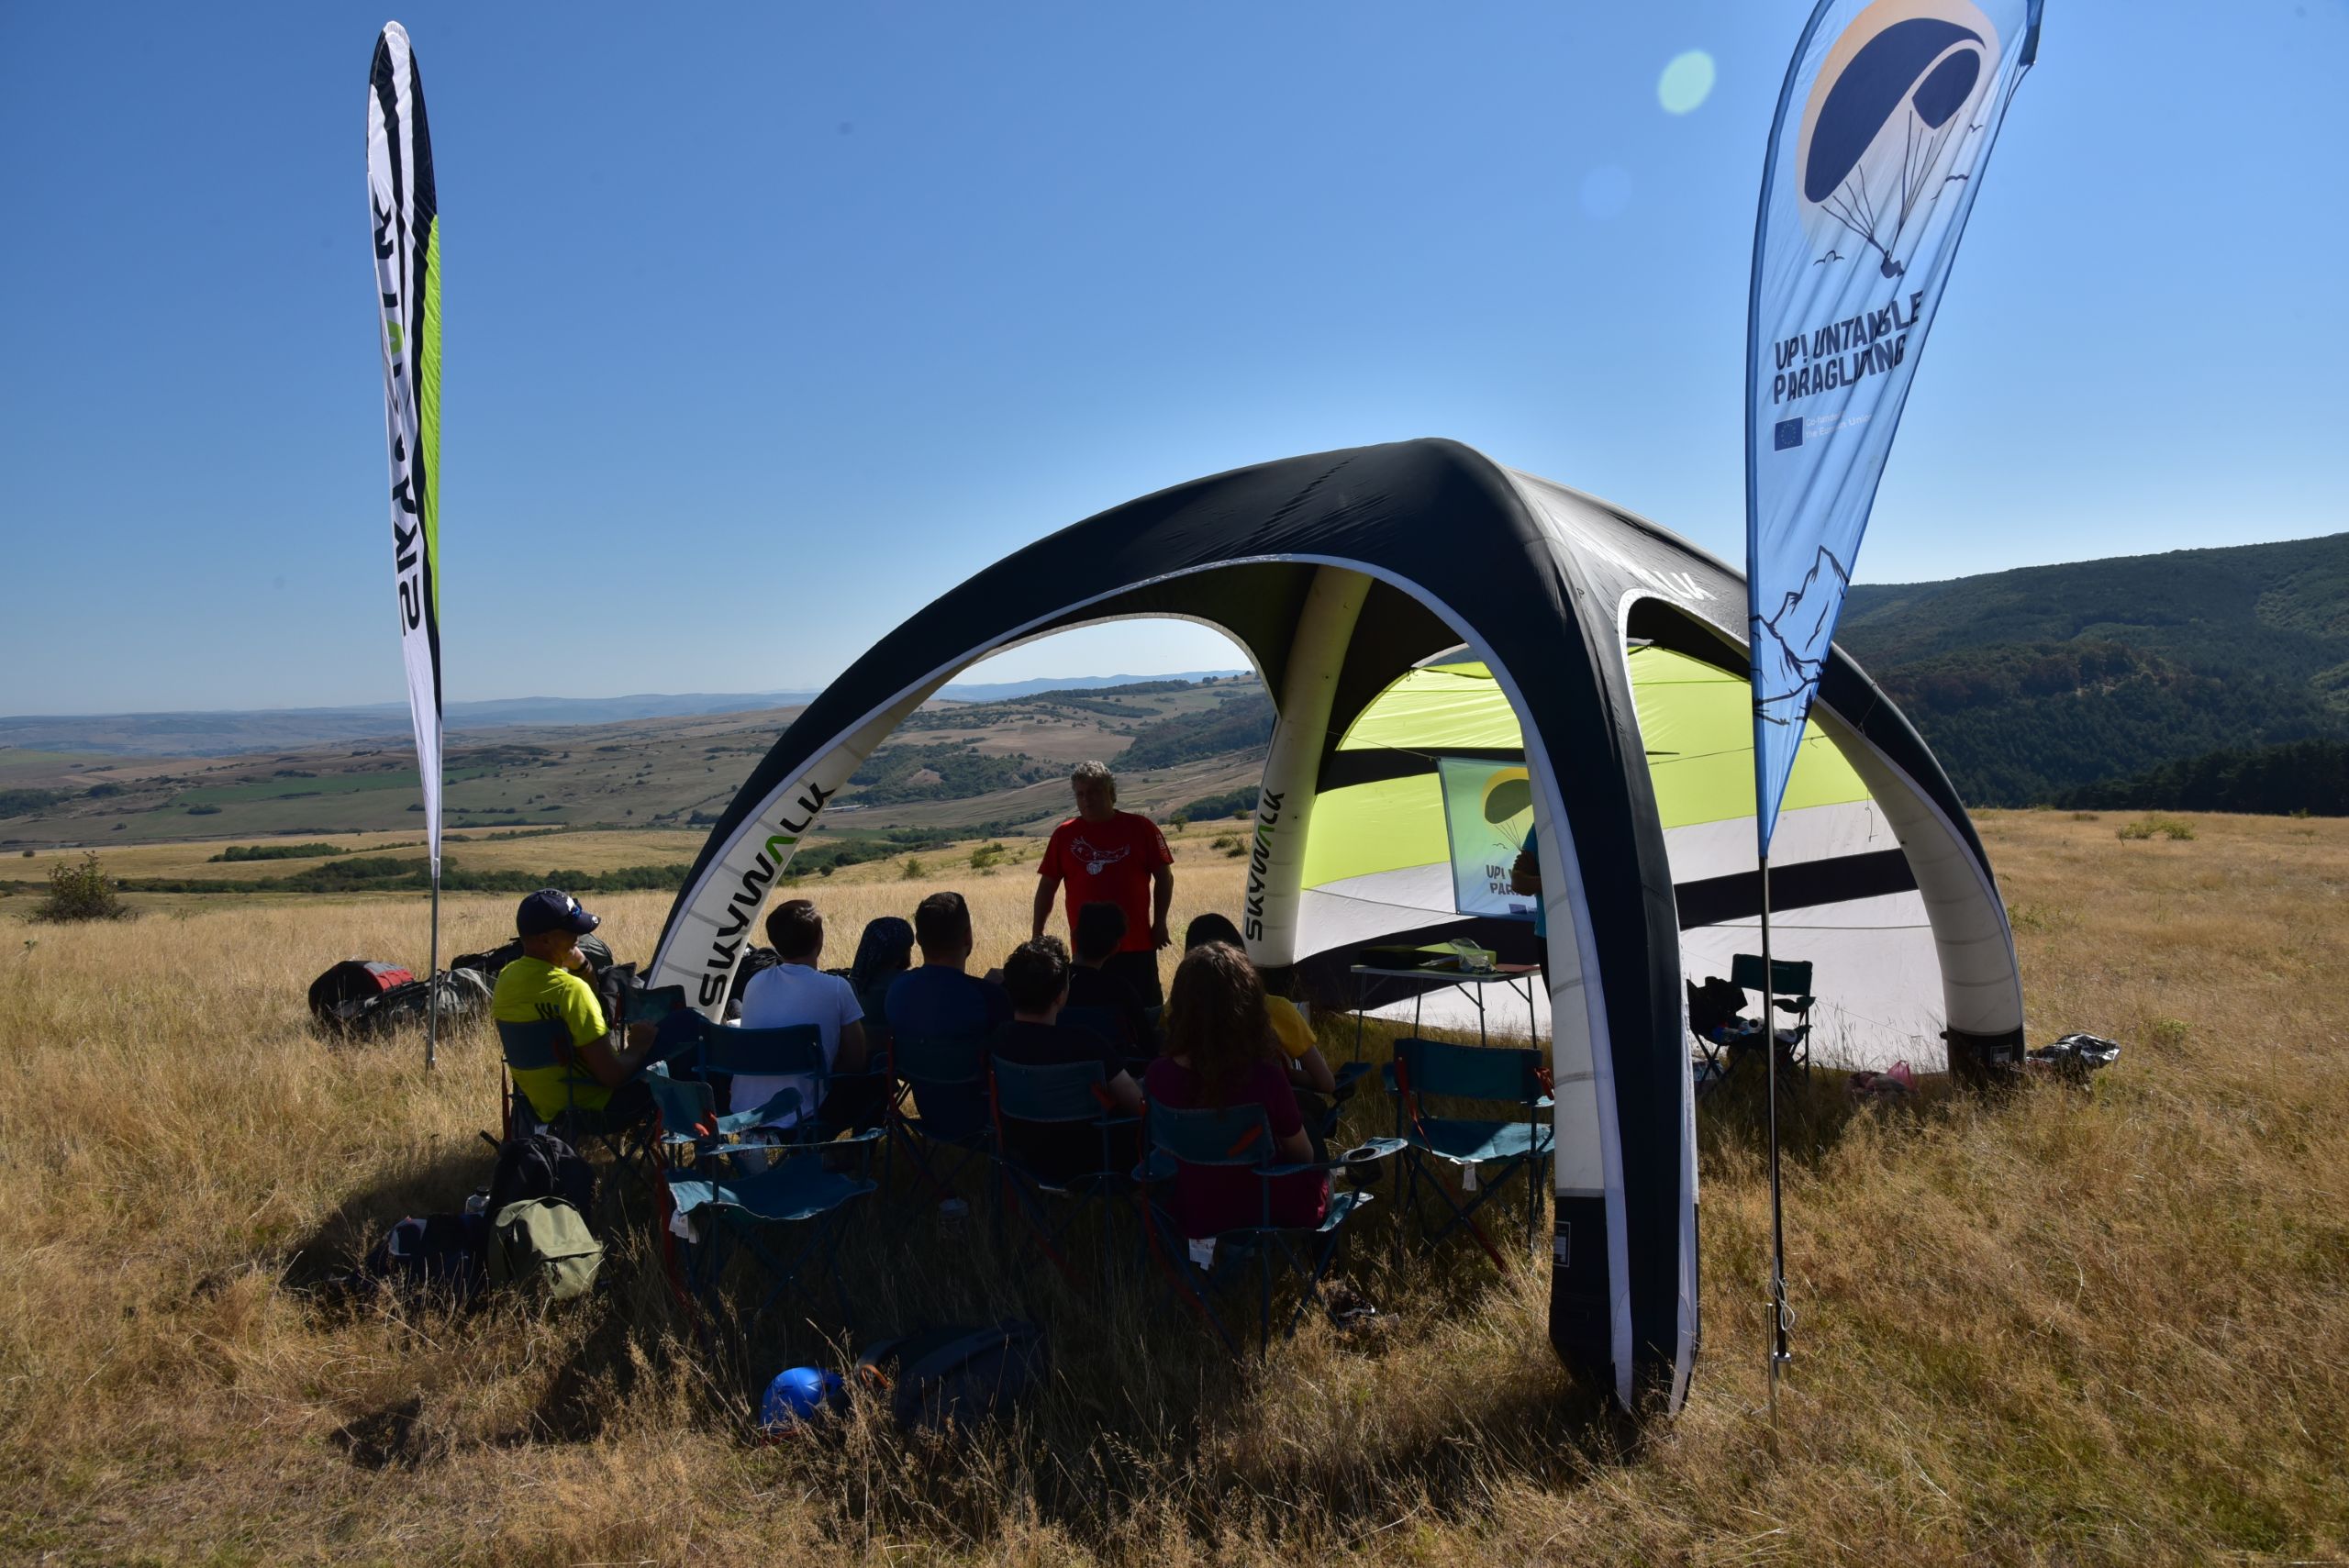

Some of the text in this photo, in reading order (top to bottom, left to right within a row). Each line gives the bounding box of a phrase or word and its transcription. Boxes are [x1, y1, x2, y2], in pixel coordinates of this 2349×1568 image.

[1775, 334, 1808, 371] UP!
[698, 783, 837, 1007] SKYWALK
[1245, 788, 1285, 941] SKYWALK
[1486, 864, 1506, 879] UP!
